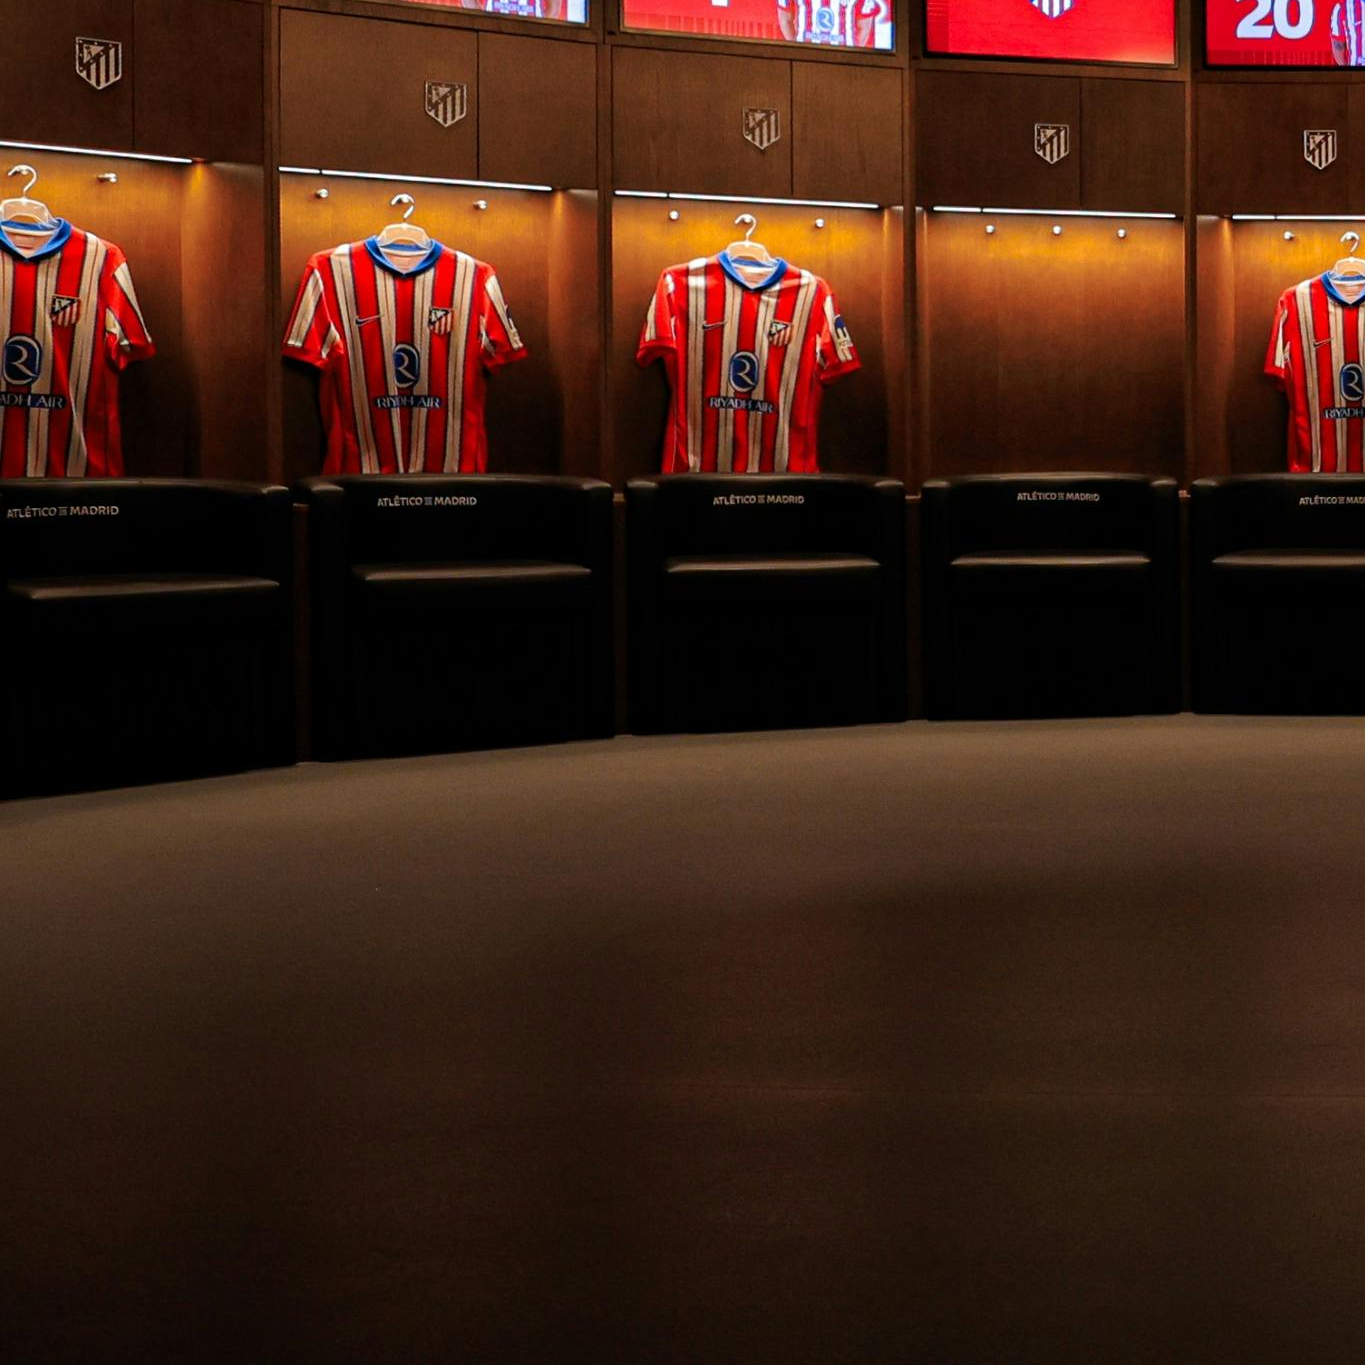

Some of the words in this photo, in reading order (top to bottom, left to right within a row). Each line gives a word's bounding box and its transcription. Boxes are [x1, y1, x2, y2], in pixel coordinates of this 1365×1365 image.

[35, 395, 64, 409] AIR
[418, 396, 440, 409] AIR
[755, 400, 774, 413] AIR
[377, 495, 424, 507] ATLÉTICO
[433, 496, 478, 506] MADRID
[712, 493, 757, 506] ATLÉTICO
[766, 494, 805, 504] MADRID
[1016, 490, 1058, 501] ATLÉTICO
[1065, 492, 1101, 502] MADRID
[1298, 494, 1338, 506] ATLÉTICO
[5, 505, 57, 519] ATLÉTICO
[69, 505, 120, 516] MADRID
